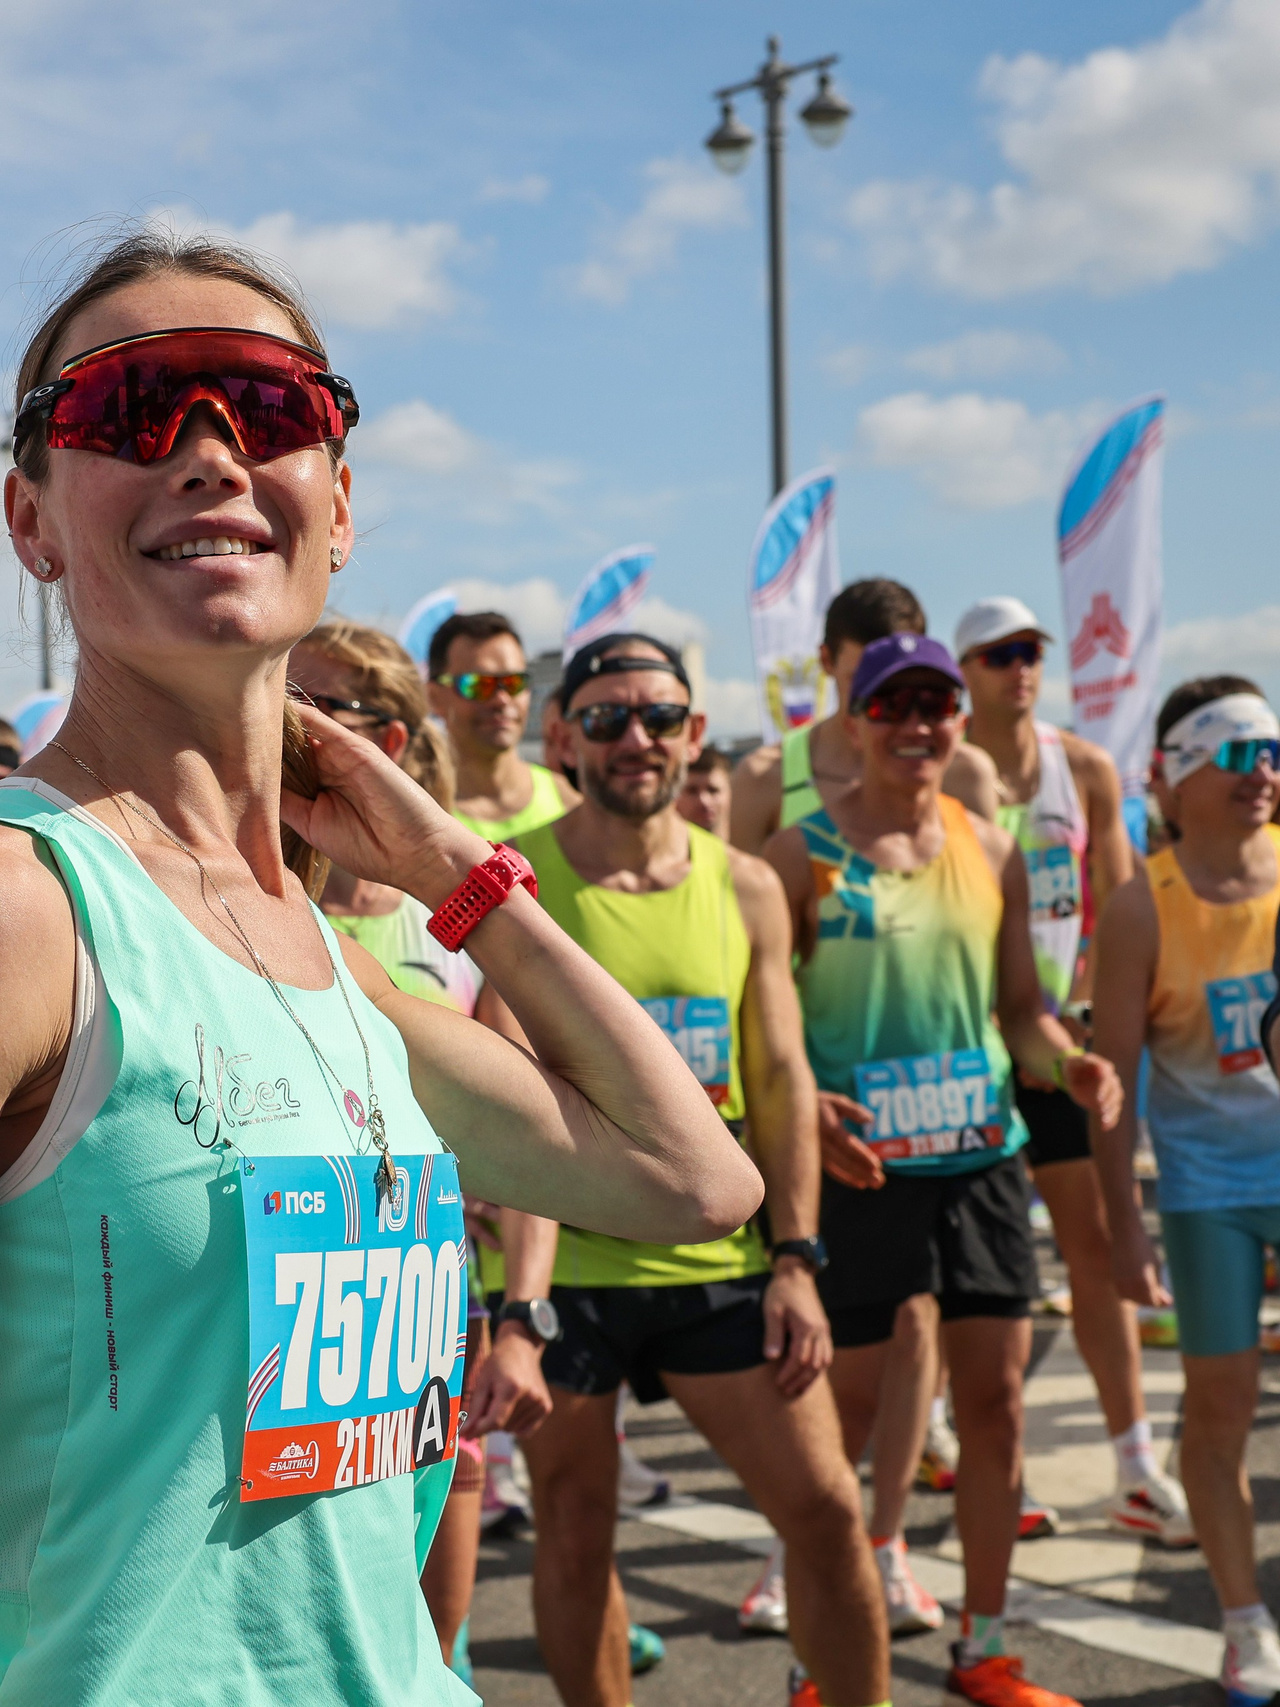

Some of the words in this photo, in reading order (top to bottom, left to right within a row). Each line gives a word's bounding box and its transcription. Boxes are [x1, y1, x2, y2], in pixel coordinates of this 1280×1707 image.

[867, 1076, 987, 1137] 70897
[285, 1191, 326, 1214] ПСБ
[100, 1214, 114, 1269] каждый
[101, 1271, 114, 1319] финиш
[275, 1240, 461, 1411] 75700
[107, 1330, 120, 1371] новый
[109, 1373, 119, 1411] старт
[415, 1384, 445, 1464] А
[276, 1457, 314, 1472] БАЛТИКА
